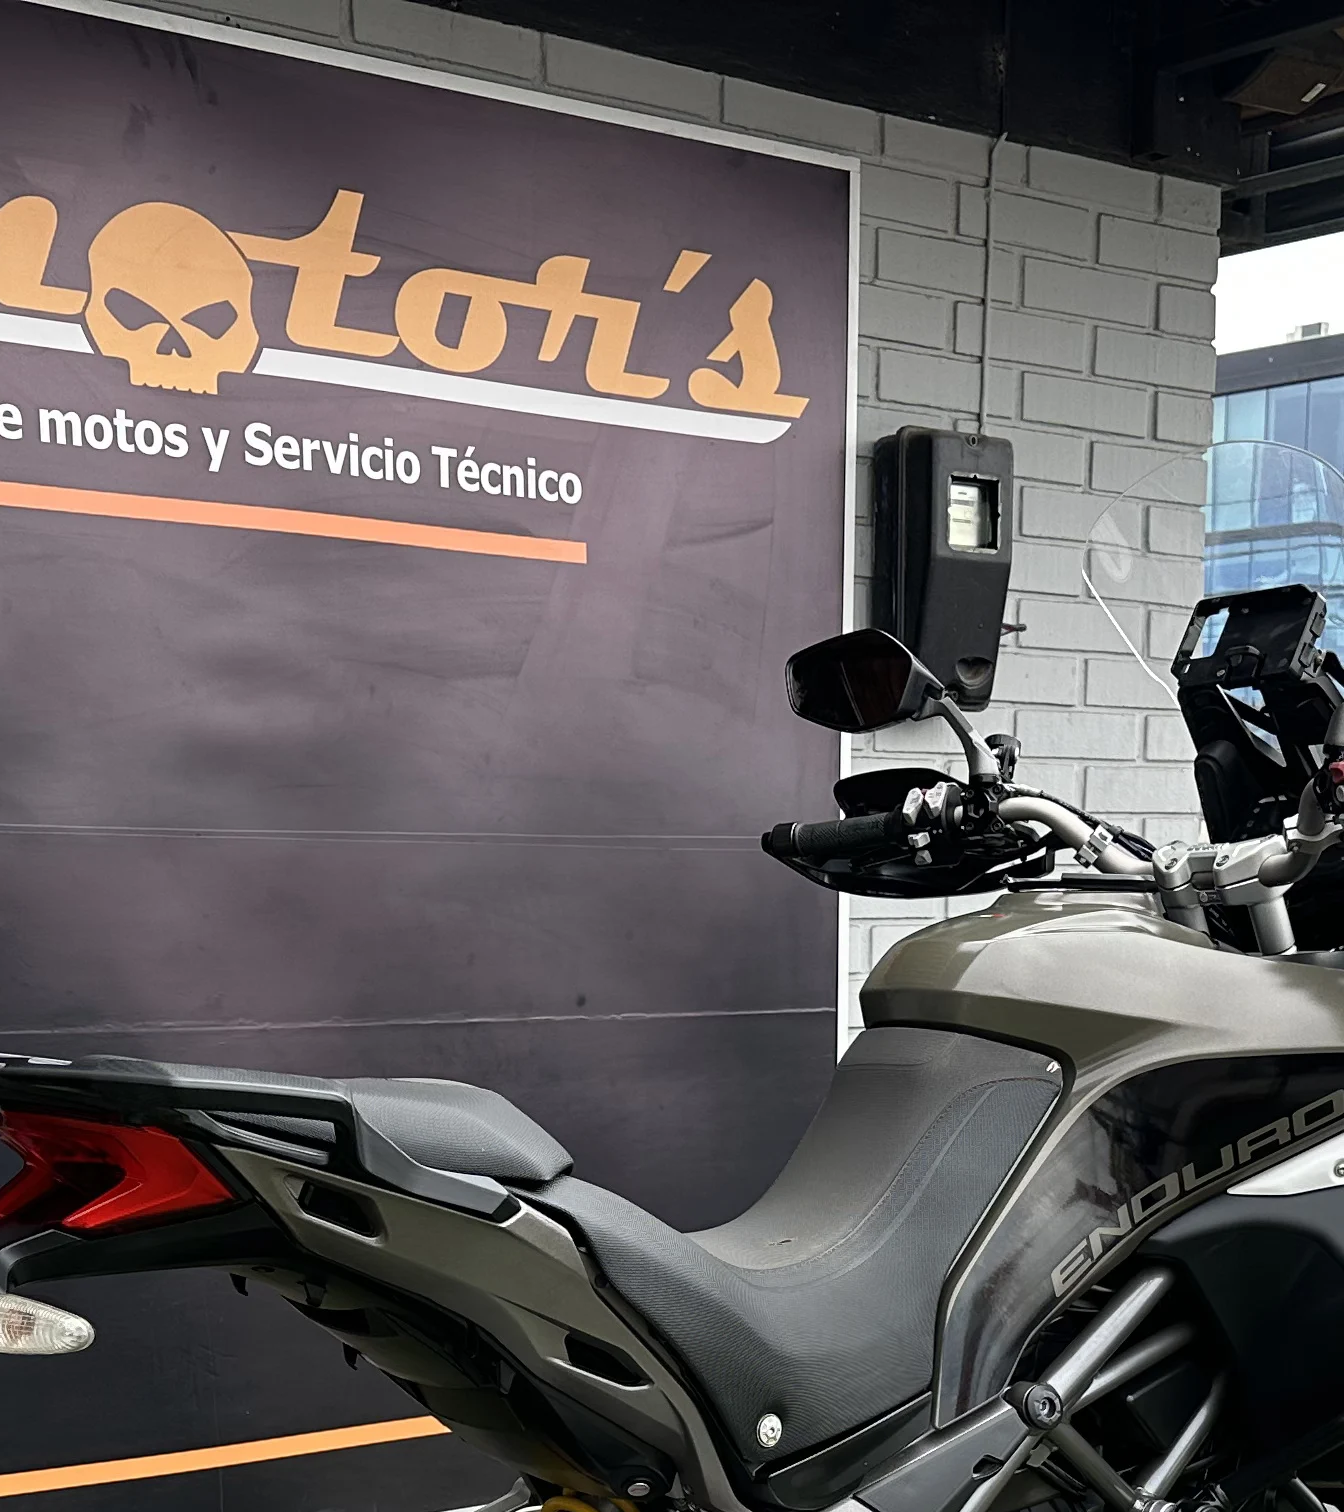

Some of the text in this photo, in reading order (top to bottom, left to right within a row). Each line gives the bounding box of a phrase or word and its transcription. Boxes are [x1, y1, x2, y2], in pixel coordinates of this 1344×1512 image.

[39, 407, 190, 462] motos
[206, 430, 230, 473] y
[244, 422, 421, 486] Servicio
[433, 444, 584, 506] Técnico
